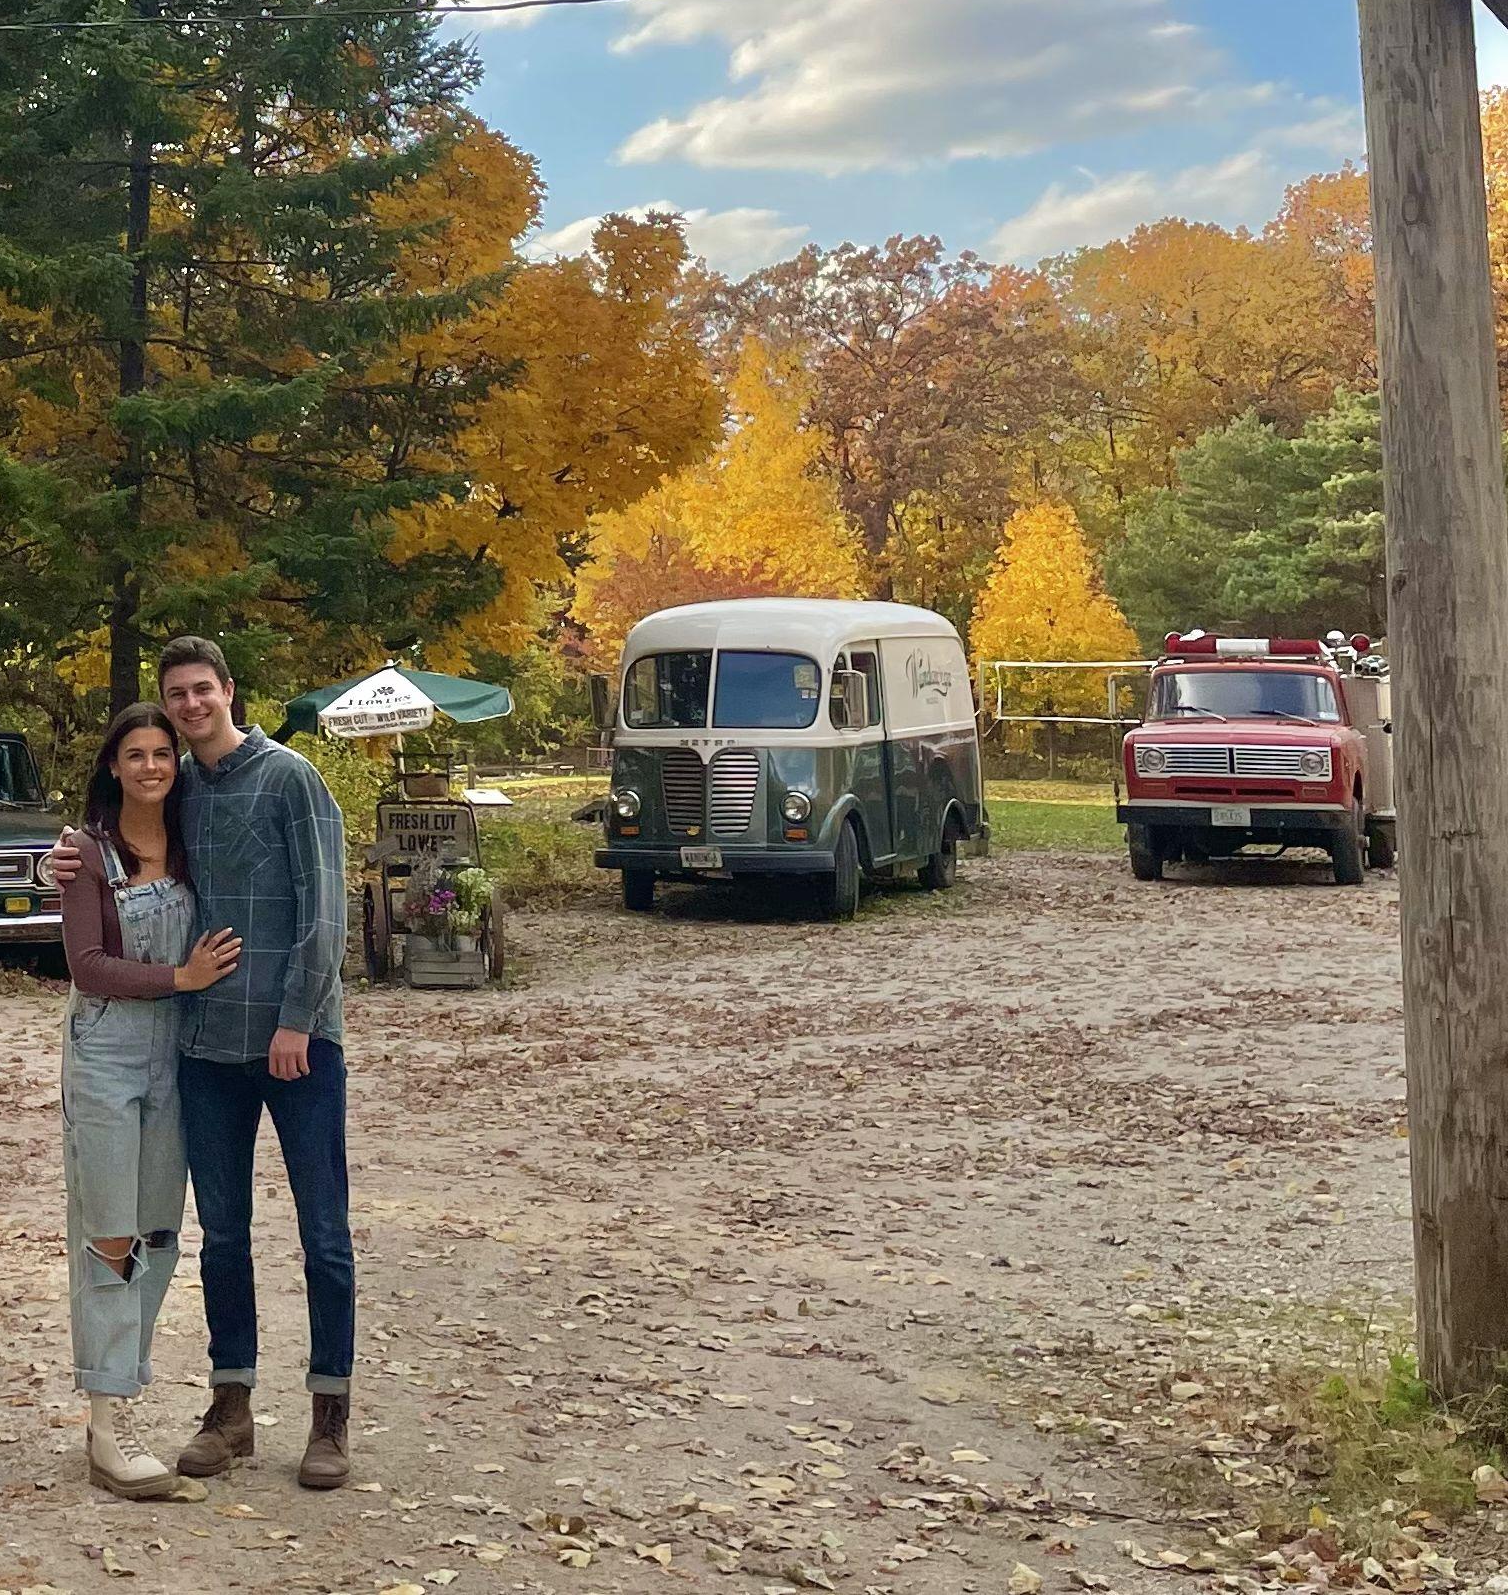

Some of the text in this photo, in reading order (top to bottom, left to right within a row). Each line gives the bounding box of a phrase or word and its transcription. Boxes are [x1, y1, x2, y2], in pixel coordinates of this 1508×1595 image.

[328, 716, 352, 727] FRESH
[353, 713, 369, 725] CUT
[377, 711, 396, 723] WILD
[396, 707, 428, 721] VARIETY
[388, 813, 456, 830] FRESH CUT
[396, 834, 455, 852] LOWE
